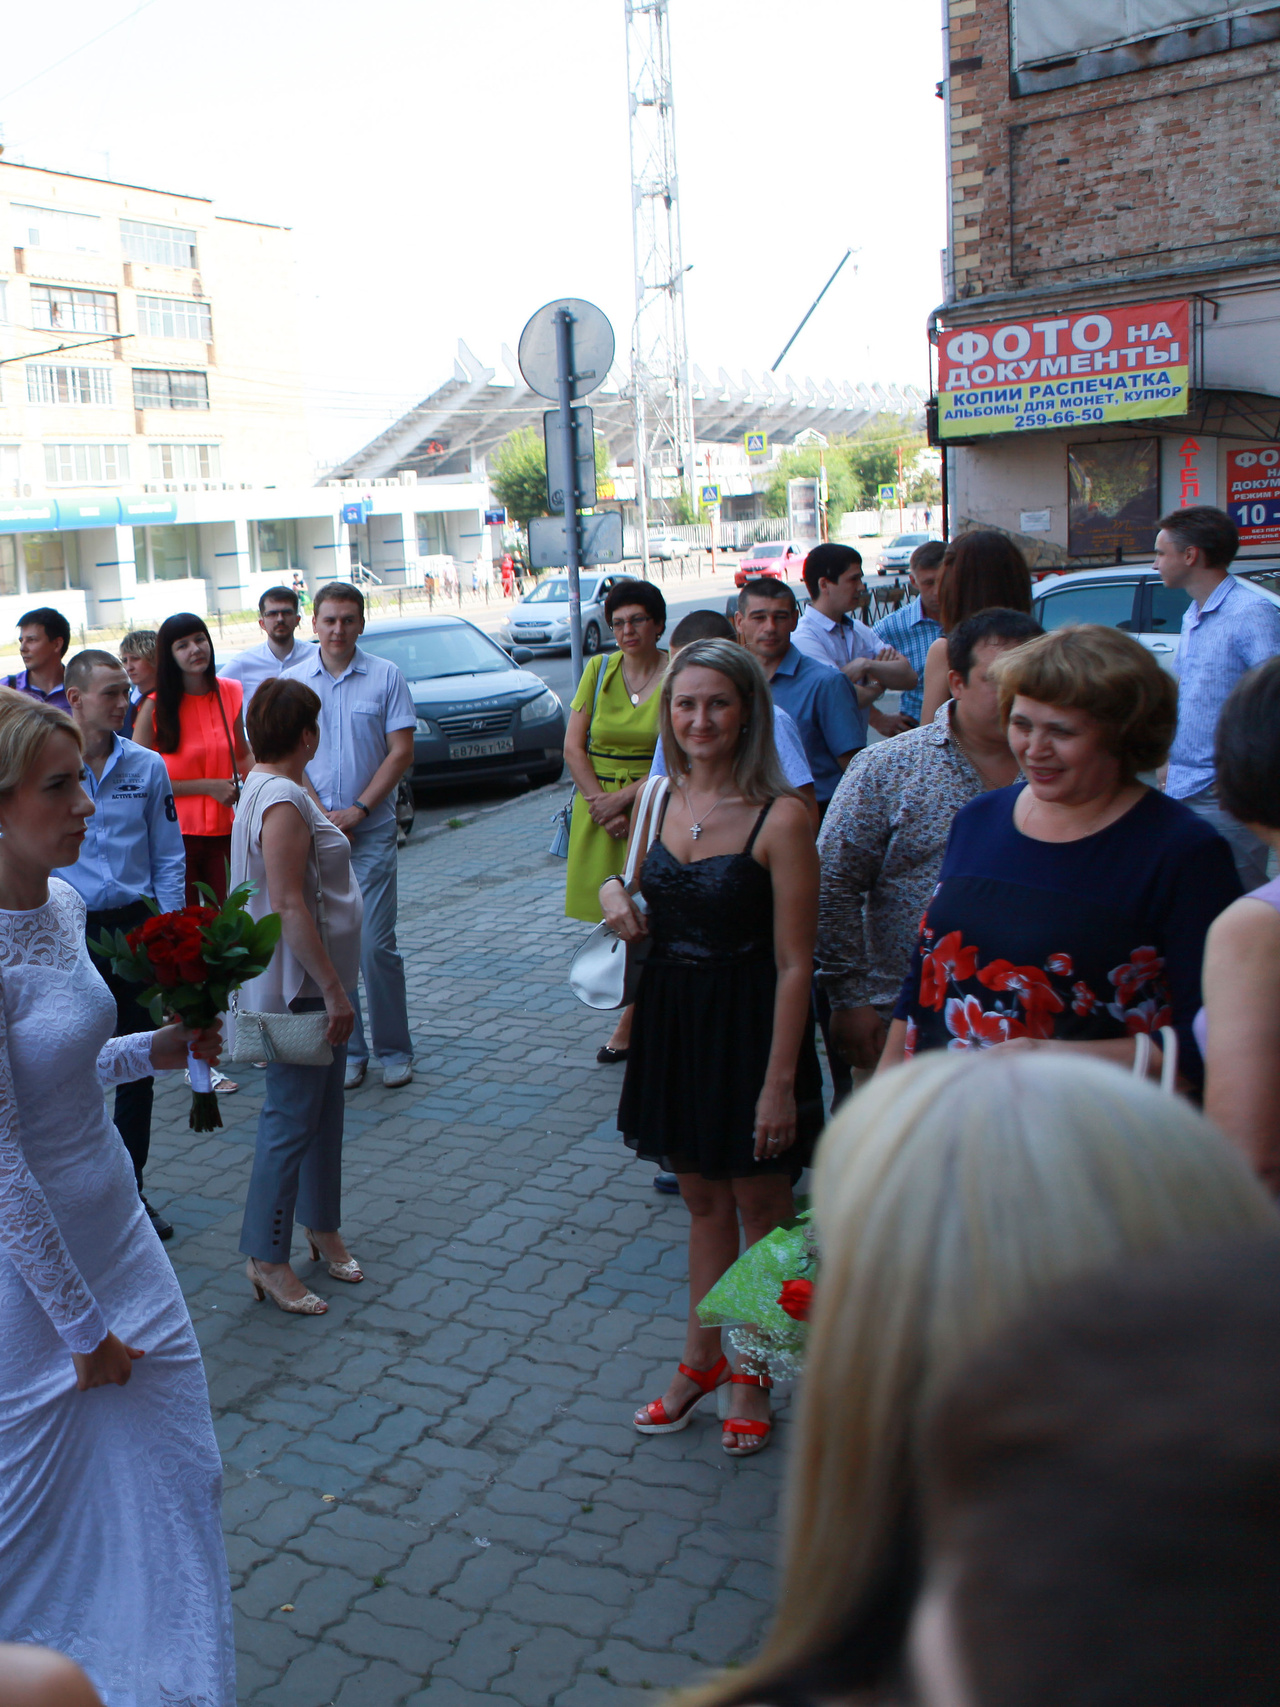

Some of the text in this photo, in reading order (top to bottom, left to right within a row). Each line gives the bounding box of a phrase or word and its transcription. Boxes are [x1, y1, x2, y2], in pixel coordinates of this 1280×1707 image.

[946, 314, 1174, 366] ФОТО НА
[945, 342, 1180, 391] ДОКУМЕНТЫ
[944, 386, 1182, 420] АЛЬБОМЫ ДЛЯ МОНЕТ, КУПЮР
[953, 371, 1171, 407] КОПИИ РАСПЕЧАТКА
[1014, 407, 1104, 428] 259-66-50
[1234, 492, 1272, 501] РЕЖИМ
[1236, 504, 1266, 526] 10
